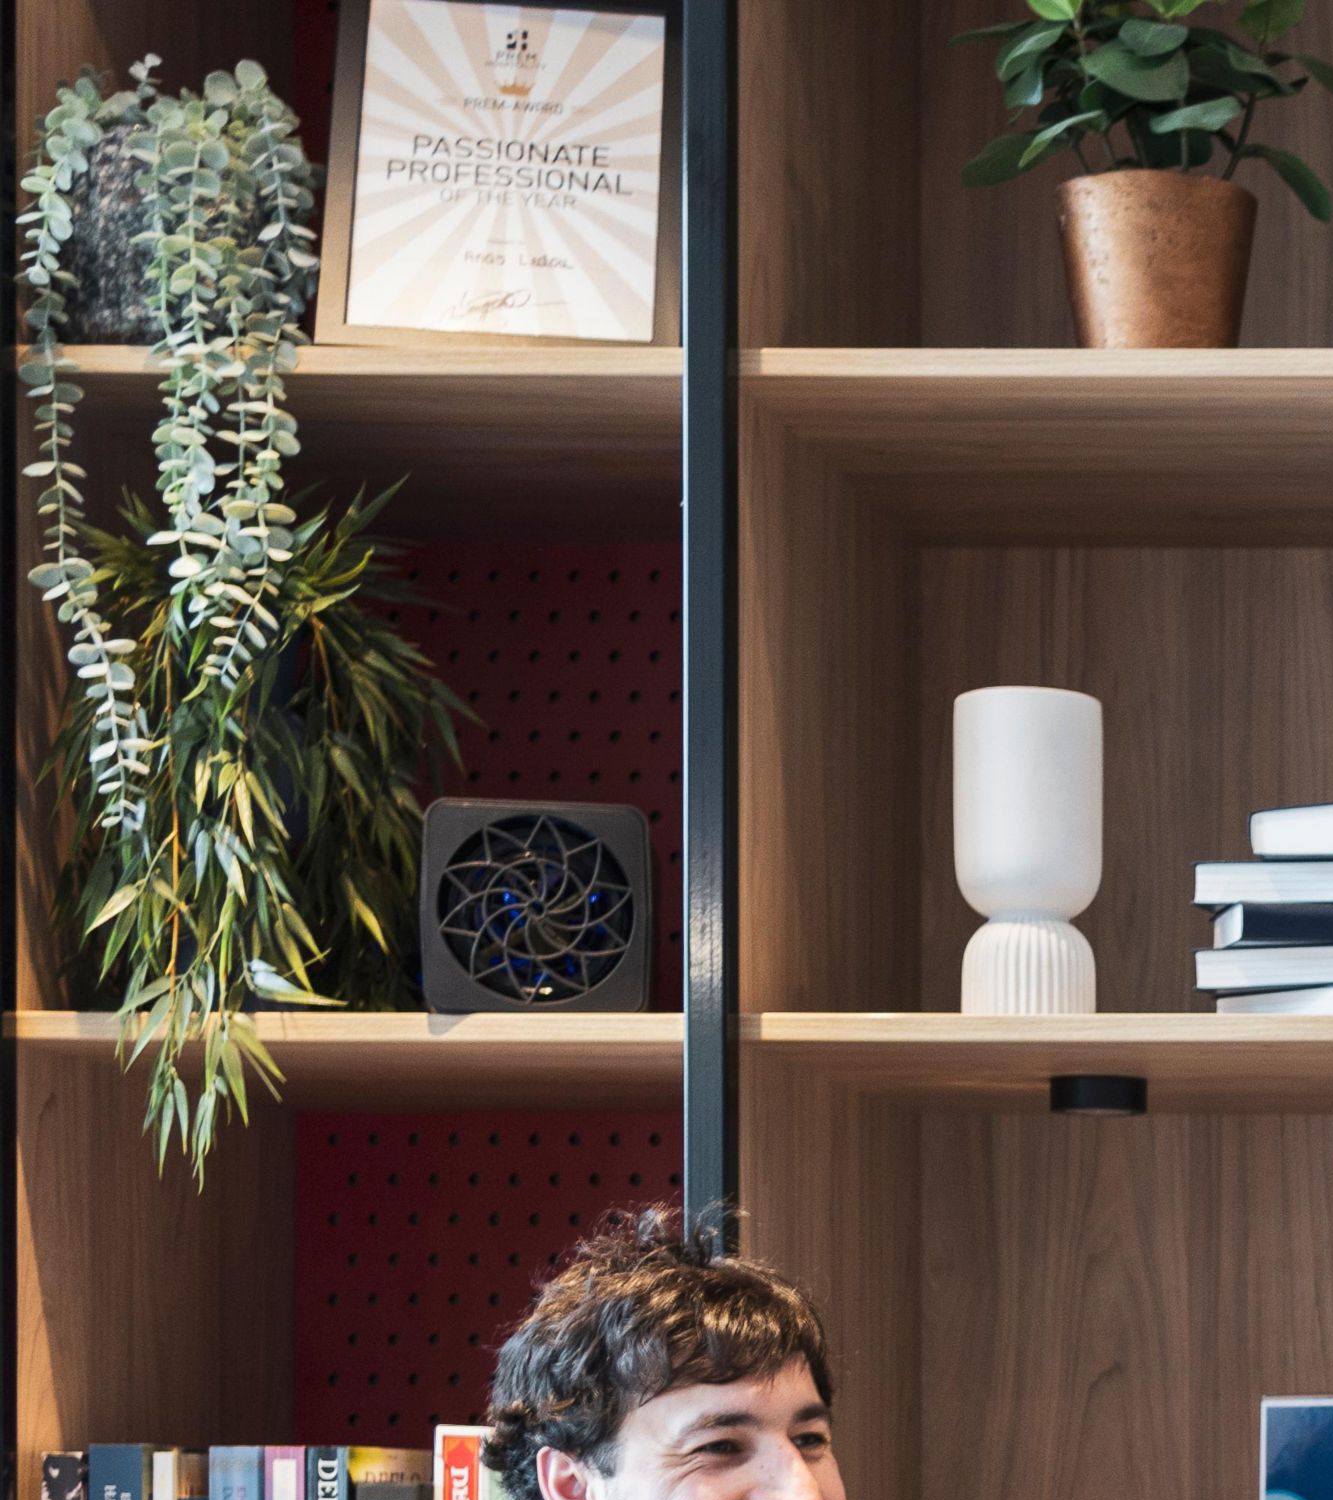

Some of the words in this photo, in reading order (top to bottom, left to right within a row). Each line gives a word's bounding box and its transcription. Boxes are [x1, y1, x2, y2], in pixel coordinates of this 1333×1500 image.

[412, 134, 610, 168] PASSIONATE
[386, 159, 633, 196] PROFESSIONAL
[521, 193, 578, 210] YEAR
